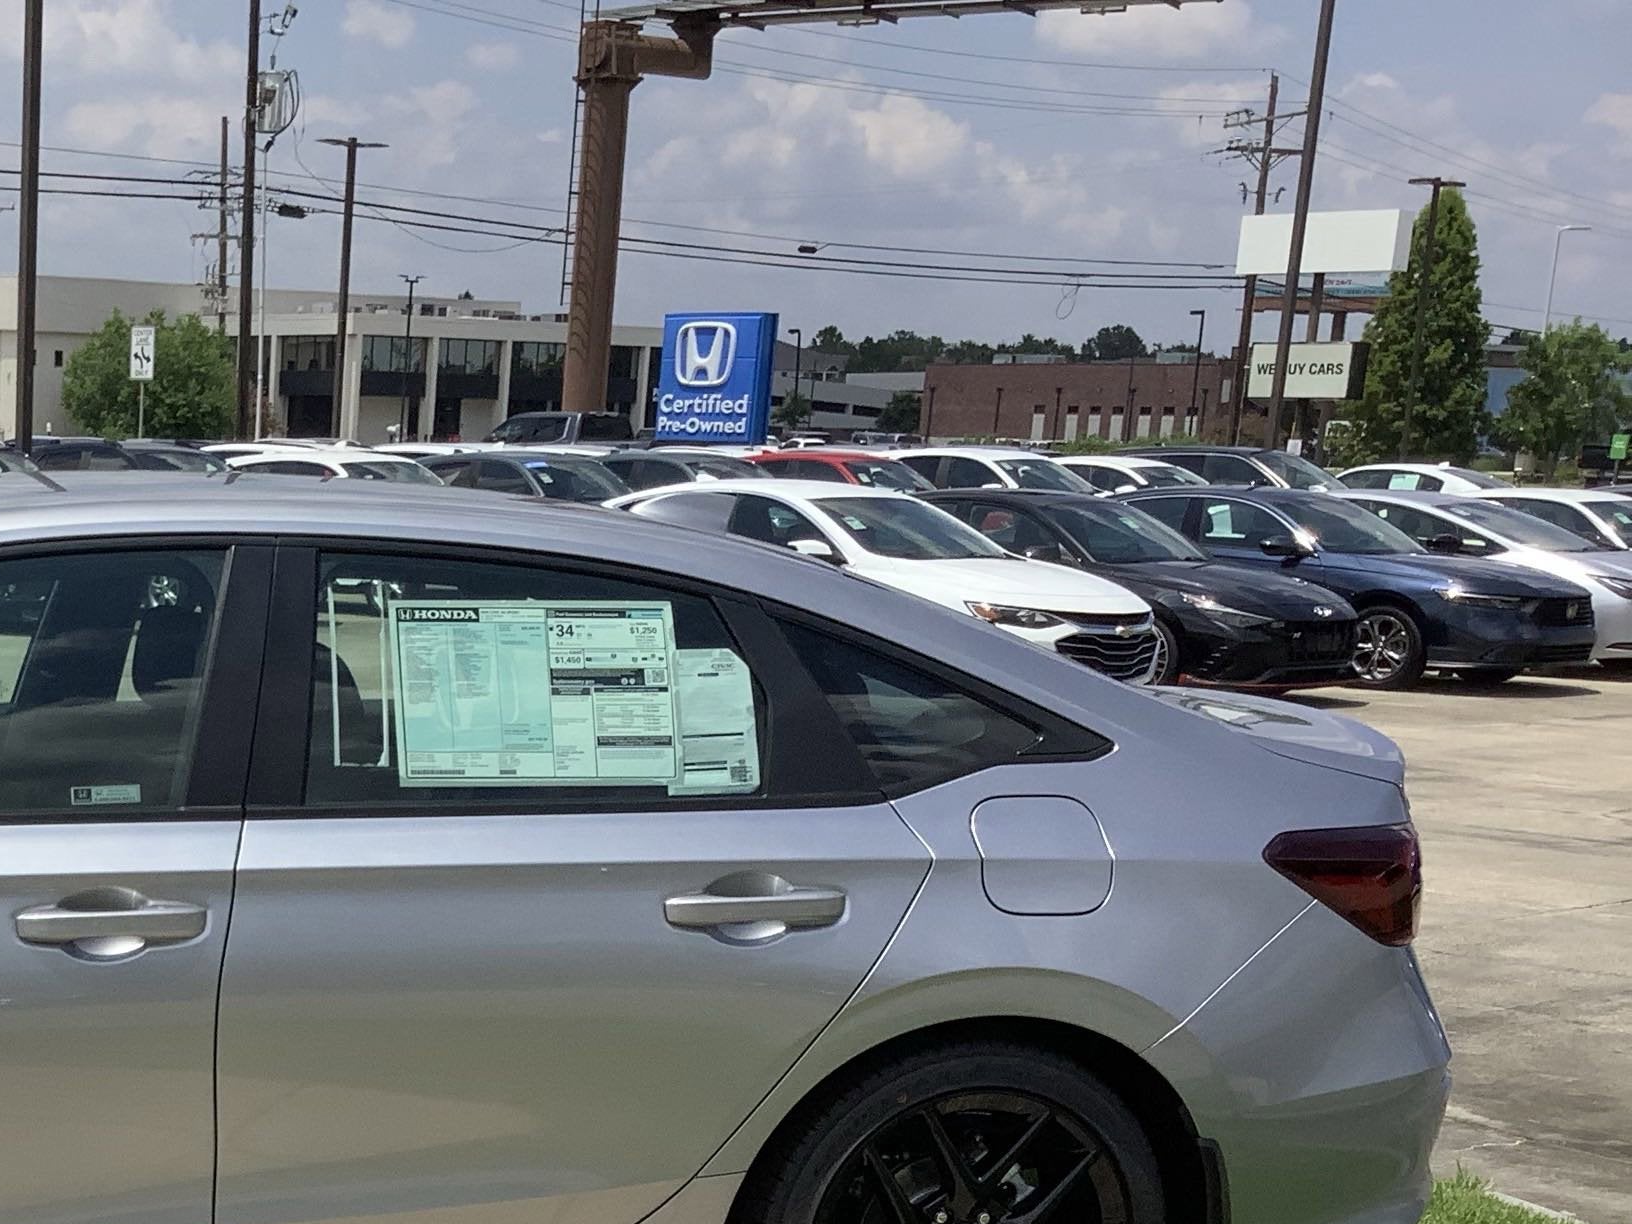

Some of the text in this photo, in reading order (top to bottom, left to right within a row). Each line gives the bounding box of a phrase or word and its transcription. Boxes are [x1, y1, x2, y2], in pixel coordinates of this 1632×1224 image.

[1257, 363, 1344, 375] WE UY CARS
[660, 393, 749, 414] Certified
[657, 416, 747, 433] Pre-Owned
[413, 609, 478, 620] HONDA
[555, 624, 575, 638] 34
[629, 626, 658, 635] $1,250
[554, 656, 582, 665] $1,450
